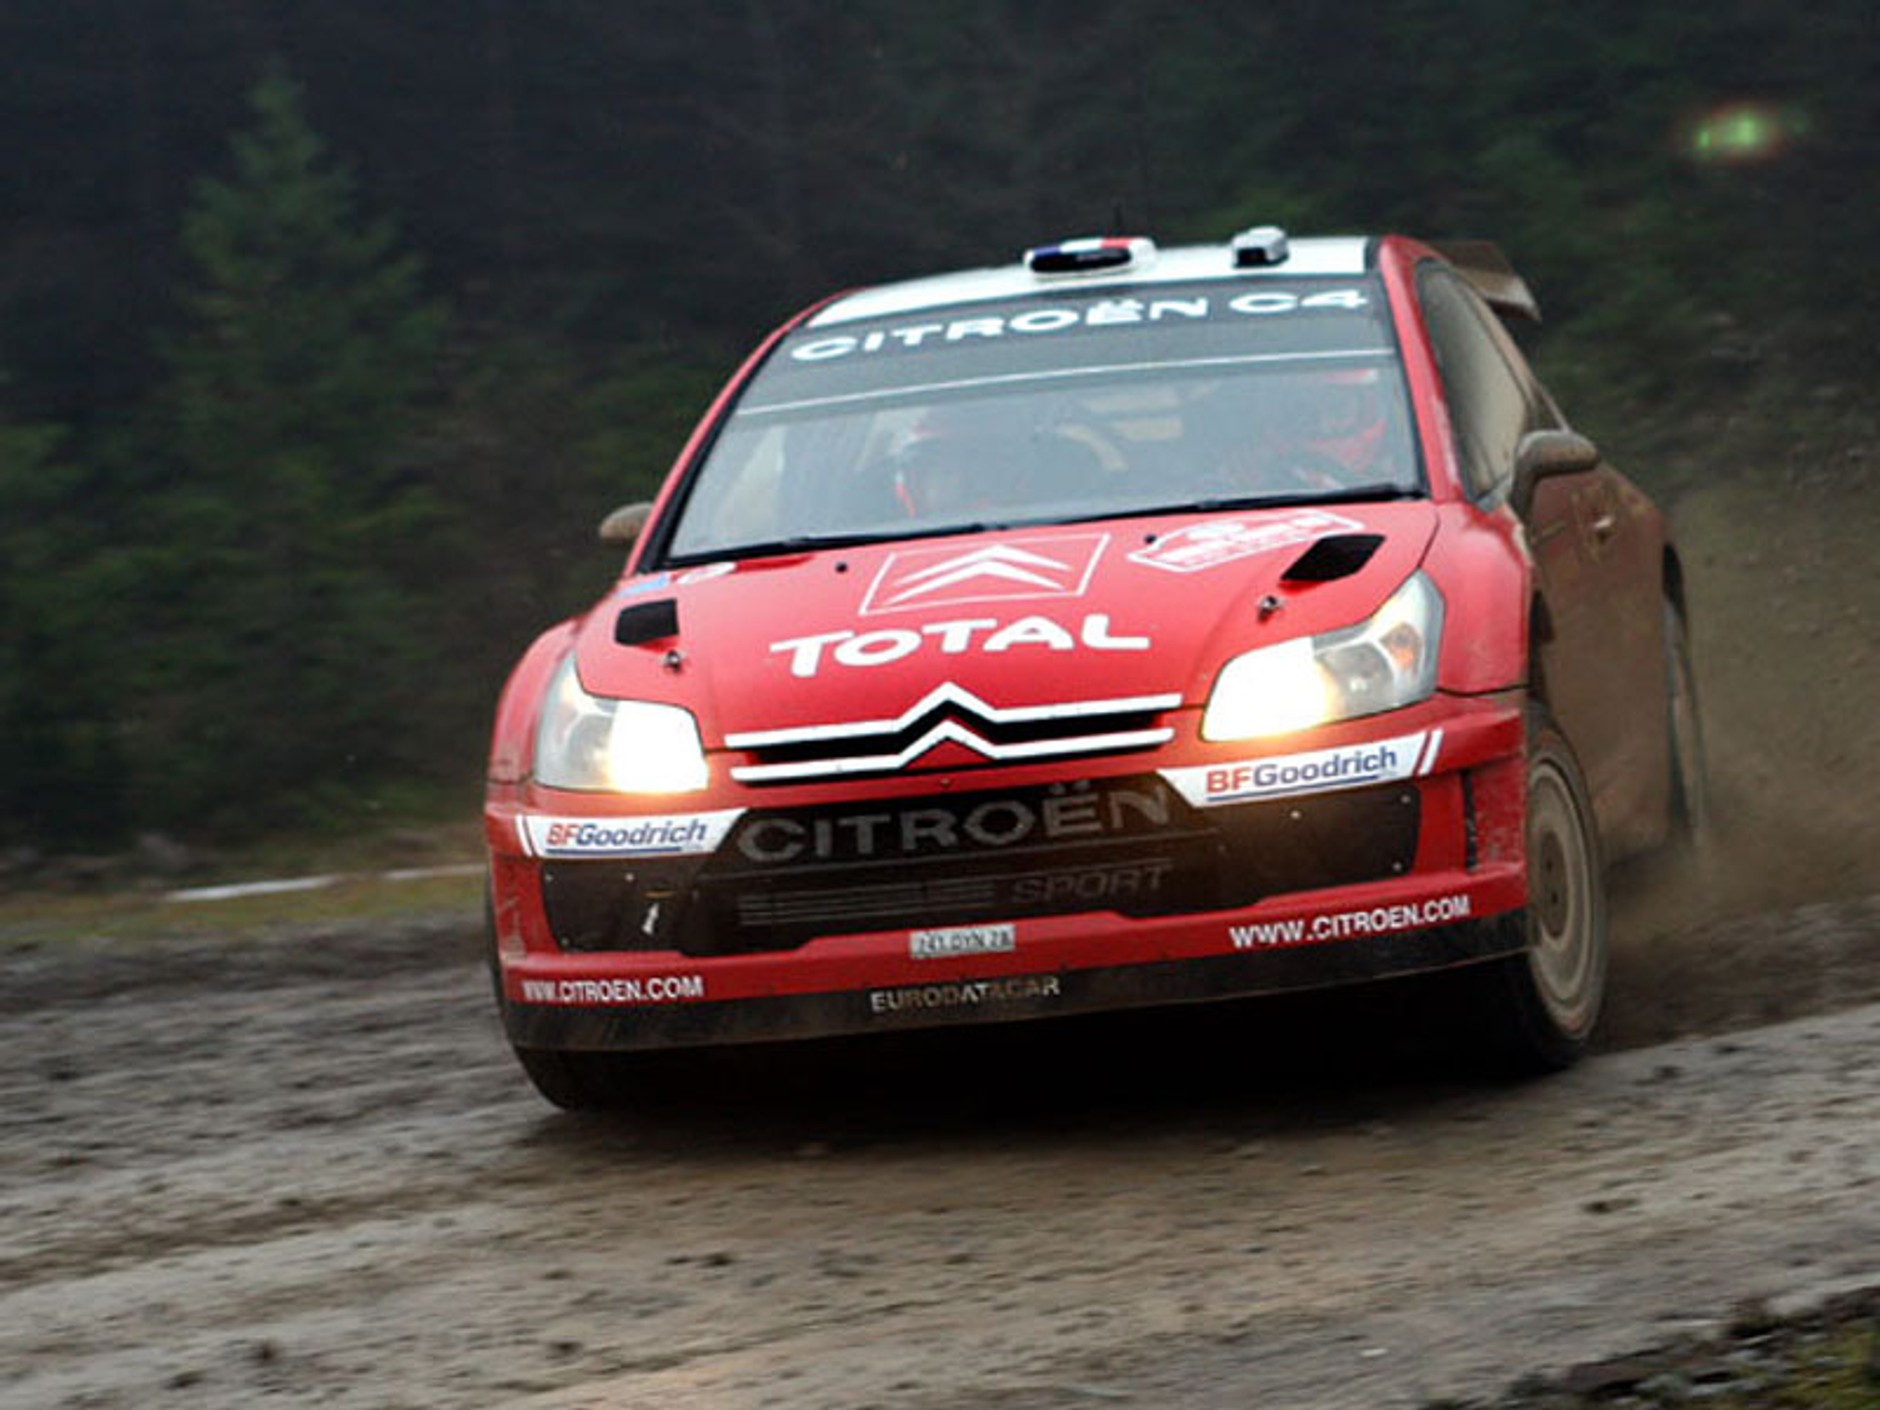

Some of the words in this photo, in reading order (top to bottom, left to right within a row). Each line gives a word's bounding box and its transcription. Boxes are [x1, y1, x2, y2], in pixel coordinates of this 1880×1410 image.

[792, 299, 1207, 361] CITROËN
[1229, 289, 1367, 314] C4
[769, 614, 1150, 677] TOTAL
[1206, 747, 1397, 793] BFGoodrich
[546, 820, 706, 848] BFGoodrich
[737, 780, 1170, 862] CITROËN
[1011, 862, 1173, 904] SPORT
[1230, 896, 1470, 949] WWW.CITROEN.COM
